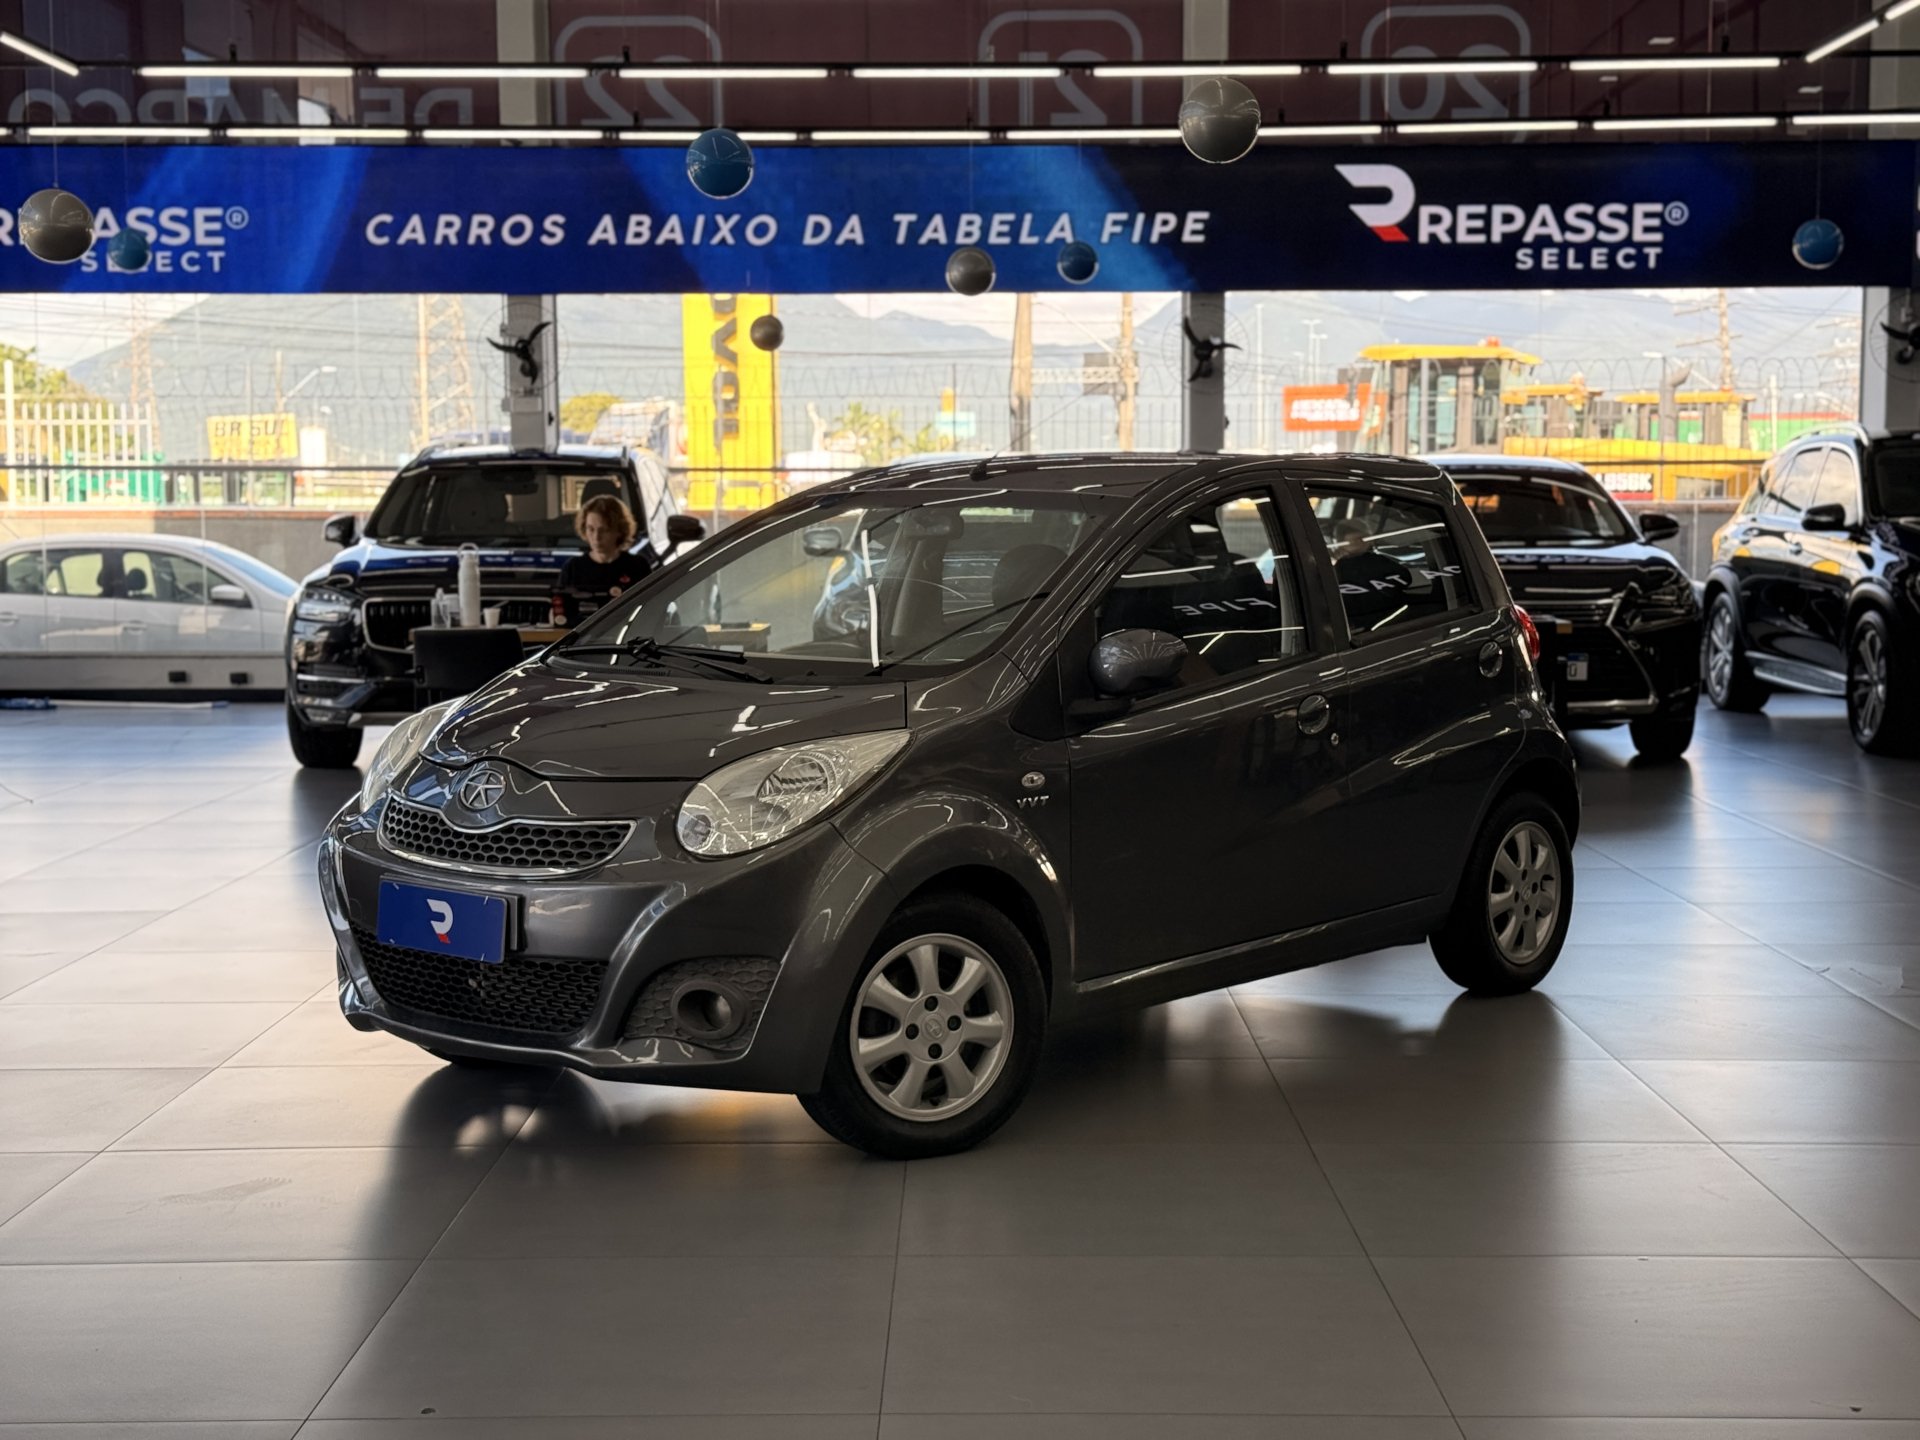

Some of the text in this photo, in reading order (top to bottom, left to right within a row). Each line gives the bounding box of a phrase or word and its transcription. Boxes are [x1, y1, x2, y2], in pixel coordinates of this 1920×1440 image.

[365, 211, 1211, 247] CARROS ABAIXO DA TABELA FIPE
[1515, 247, 1663, 270] SELECT
[1016, 795, 1050, 809] VVT
